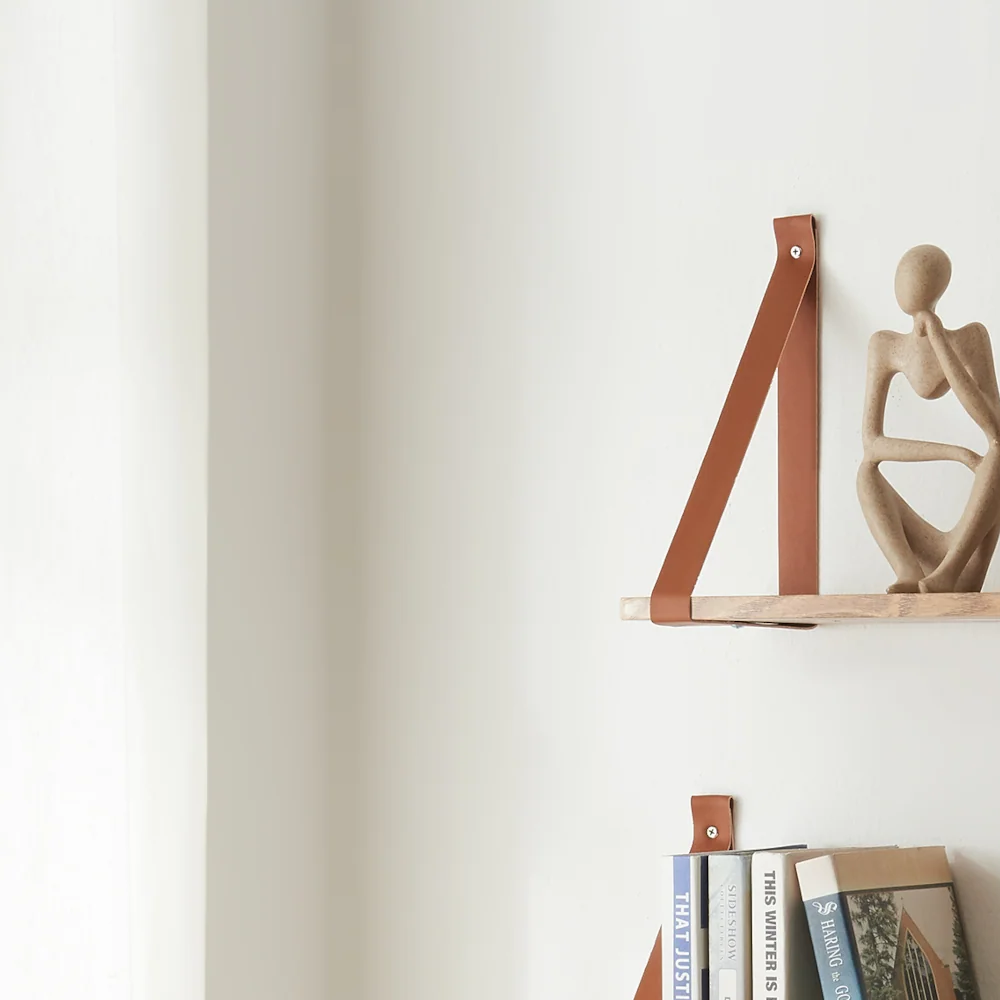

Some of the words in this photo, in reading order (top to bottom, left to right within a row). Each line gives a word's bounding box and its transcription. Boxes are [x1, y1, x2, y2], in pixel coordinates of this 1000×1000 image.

[763, 870, 776, 906] THIS
[675, 892, 690, 942] THAT
[728, 884, 737, 961] SIDESHOW
[764, 910, 777, 971] WINTER
[765, 976, 778, 992] IS
[831, 971, 840, 982] the
